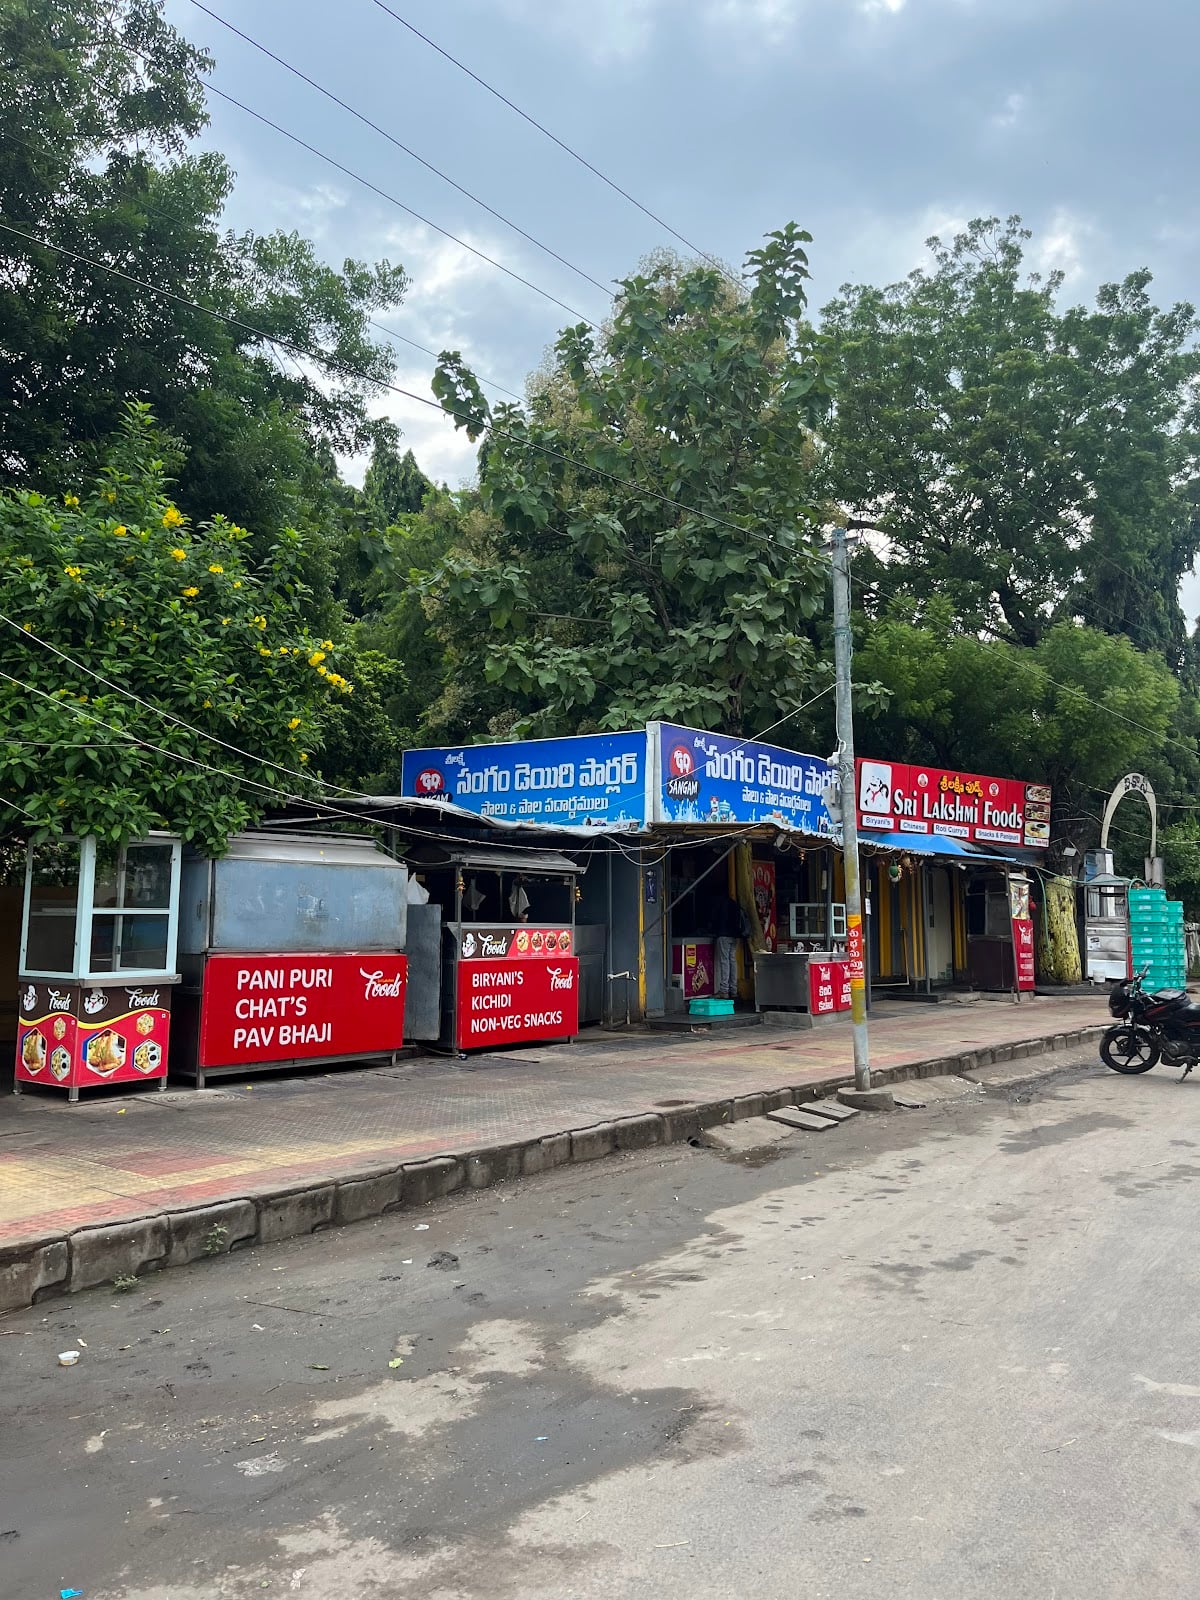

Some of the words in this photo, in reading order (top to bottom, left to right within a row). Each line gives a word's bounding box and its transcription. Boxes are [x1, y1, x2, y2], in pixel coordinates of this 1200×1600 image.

[456, 766, 510, 795] సంగం
[579, 753, 638, 794] పార్లర్
[705, 745, 755, 784] సంగం
[668, 779, 699, 797] SANGAM
[481, 800, 507, 817] పాలు
[518, 798, 542, 814] పాల
[983, 801, 1023, 829] Foods
[866, 817, 891, 826] Biryani's
[903, 822, 926, 831] Chinese
[478, 932, 508, 957] Foods
[237, 969, 285, 990] PANI
[289, 968, 333, 988] PURI
[359, 966, 403, 1001] Foods
[472, 971, 524, 988] BIRYANI'S
[546, 965, 574, 992] Foods
[47, 987, 71, 1011] Foods
[124, 986, 160, 1009] Foods
[471, 994, 512, 1011] KICHIDI
[471, 1015, 522, 1033] NON-VEG
[524, 1010, 563, 1028] SNACKS
[234, 1026, 273, 1049] PAV
[277, 1022, 332, 1046] BHAJI
